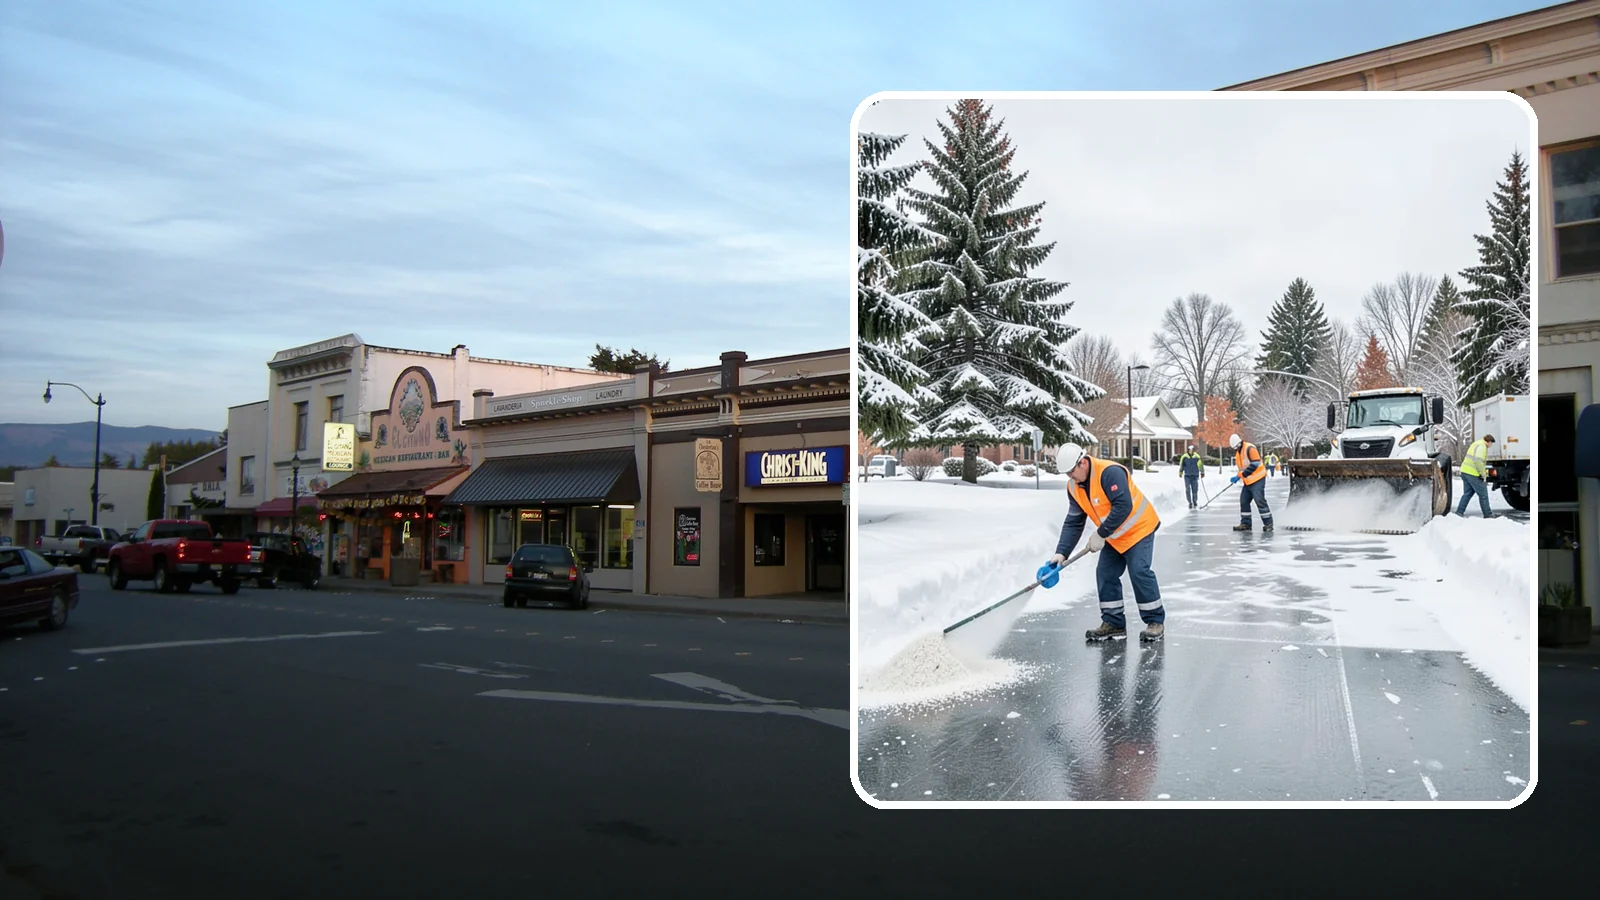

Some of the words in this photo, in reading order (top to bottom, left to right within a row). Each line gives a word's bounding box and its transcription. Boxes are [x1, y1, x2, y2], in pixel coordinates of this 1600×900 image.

[530, 397, 562, 409] Sparkle
[561, 394, 582, 405] Shop
[595, 389, 623, 400] LAUNDRY
[493, 402, 523, 413] LAVANDERIA
[392, 425, 401, 449] EL
[373, 455, 396, 465] MEXICAN
[397, 451, 434, 463] RESTAURANT
[437, 450, 450, 459] BAR
[760, 452, 797, 478] CHRIST
[799, 449, 828, 476] KING
